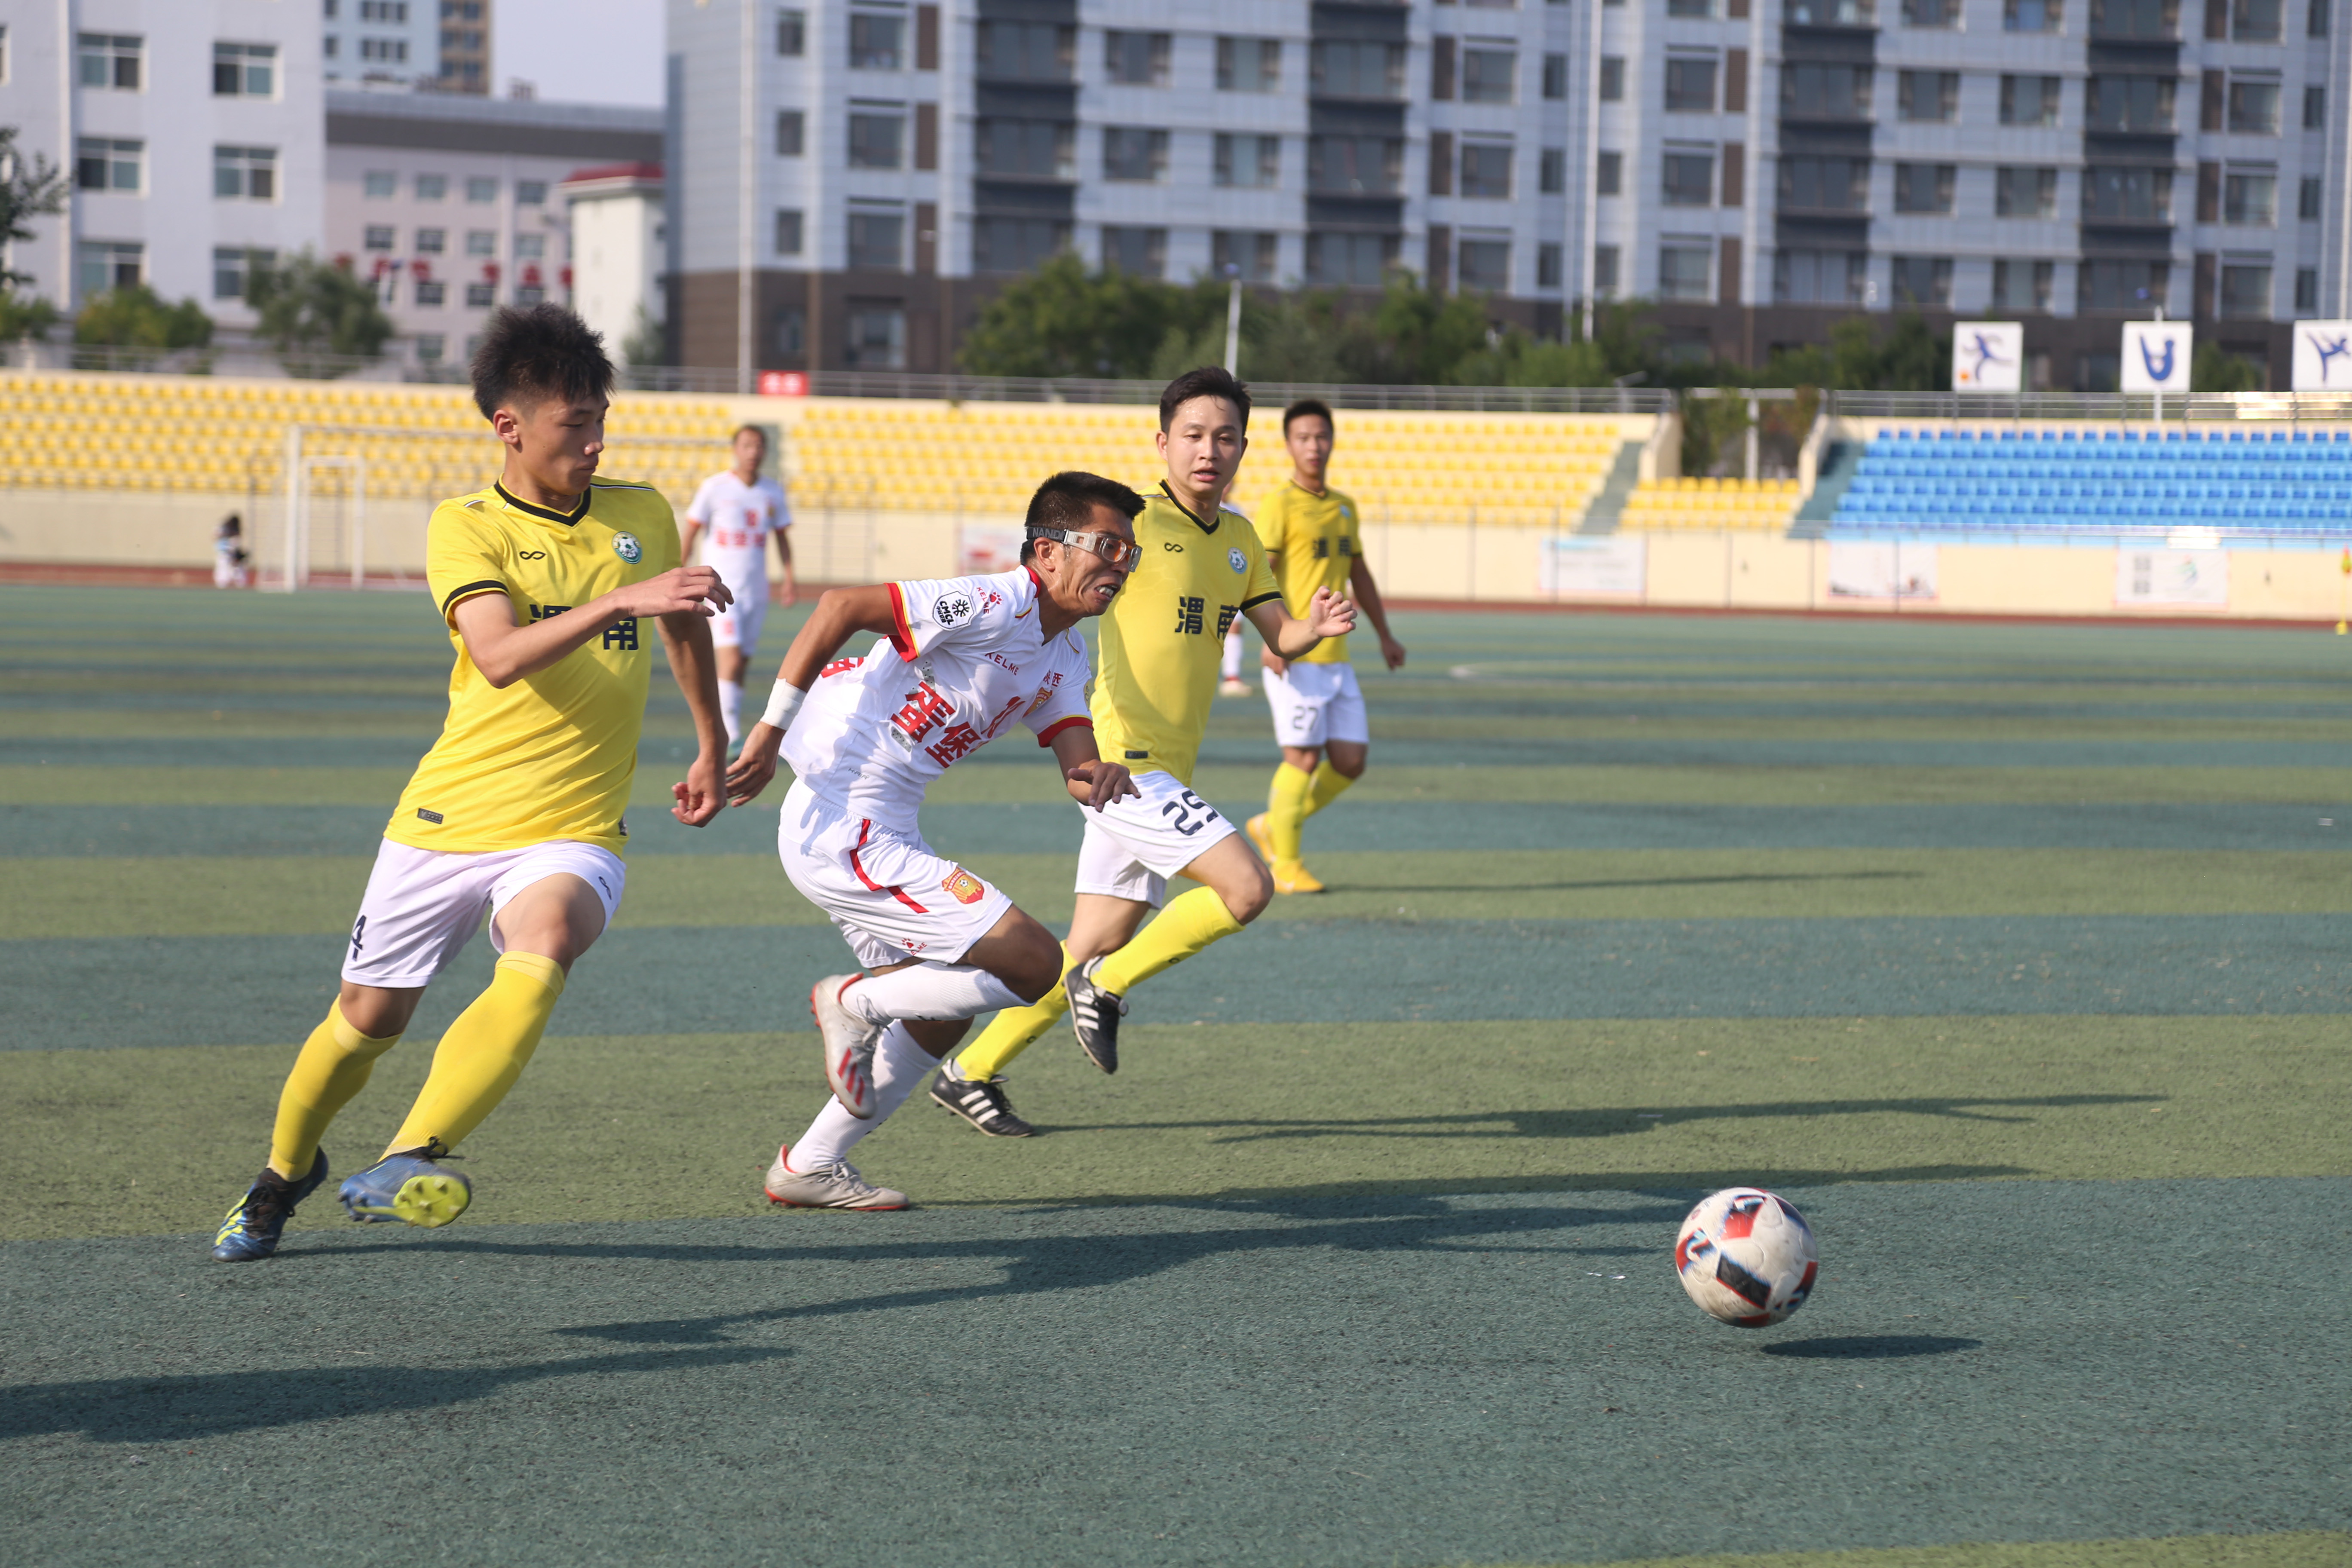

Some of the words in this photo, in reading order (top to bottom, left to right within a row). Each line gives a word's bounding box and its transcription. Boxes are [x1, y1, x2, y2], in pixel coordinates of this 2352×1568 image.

[940, 601, 955, 625] CMCL
[976, 587, 990, 614] KELME
[891, 681, 989, 769] 蛋堡
[1292, 705, 1319, 732] 27
